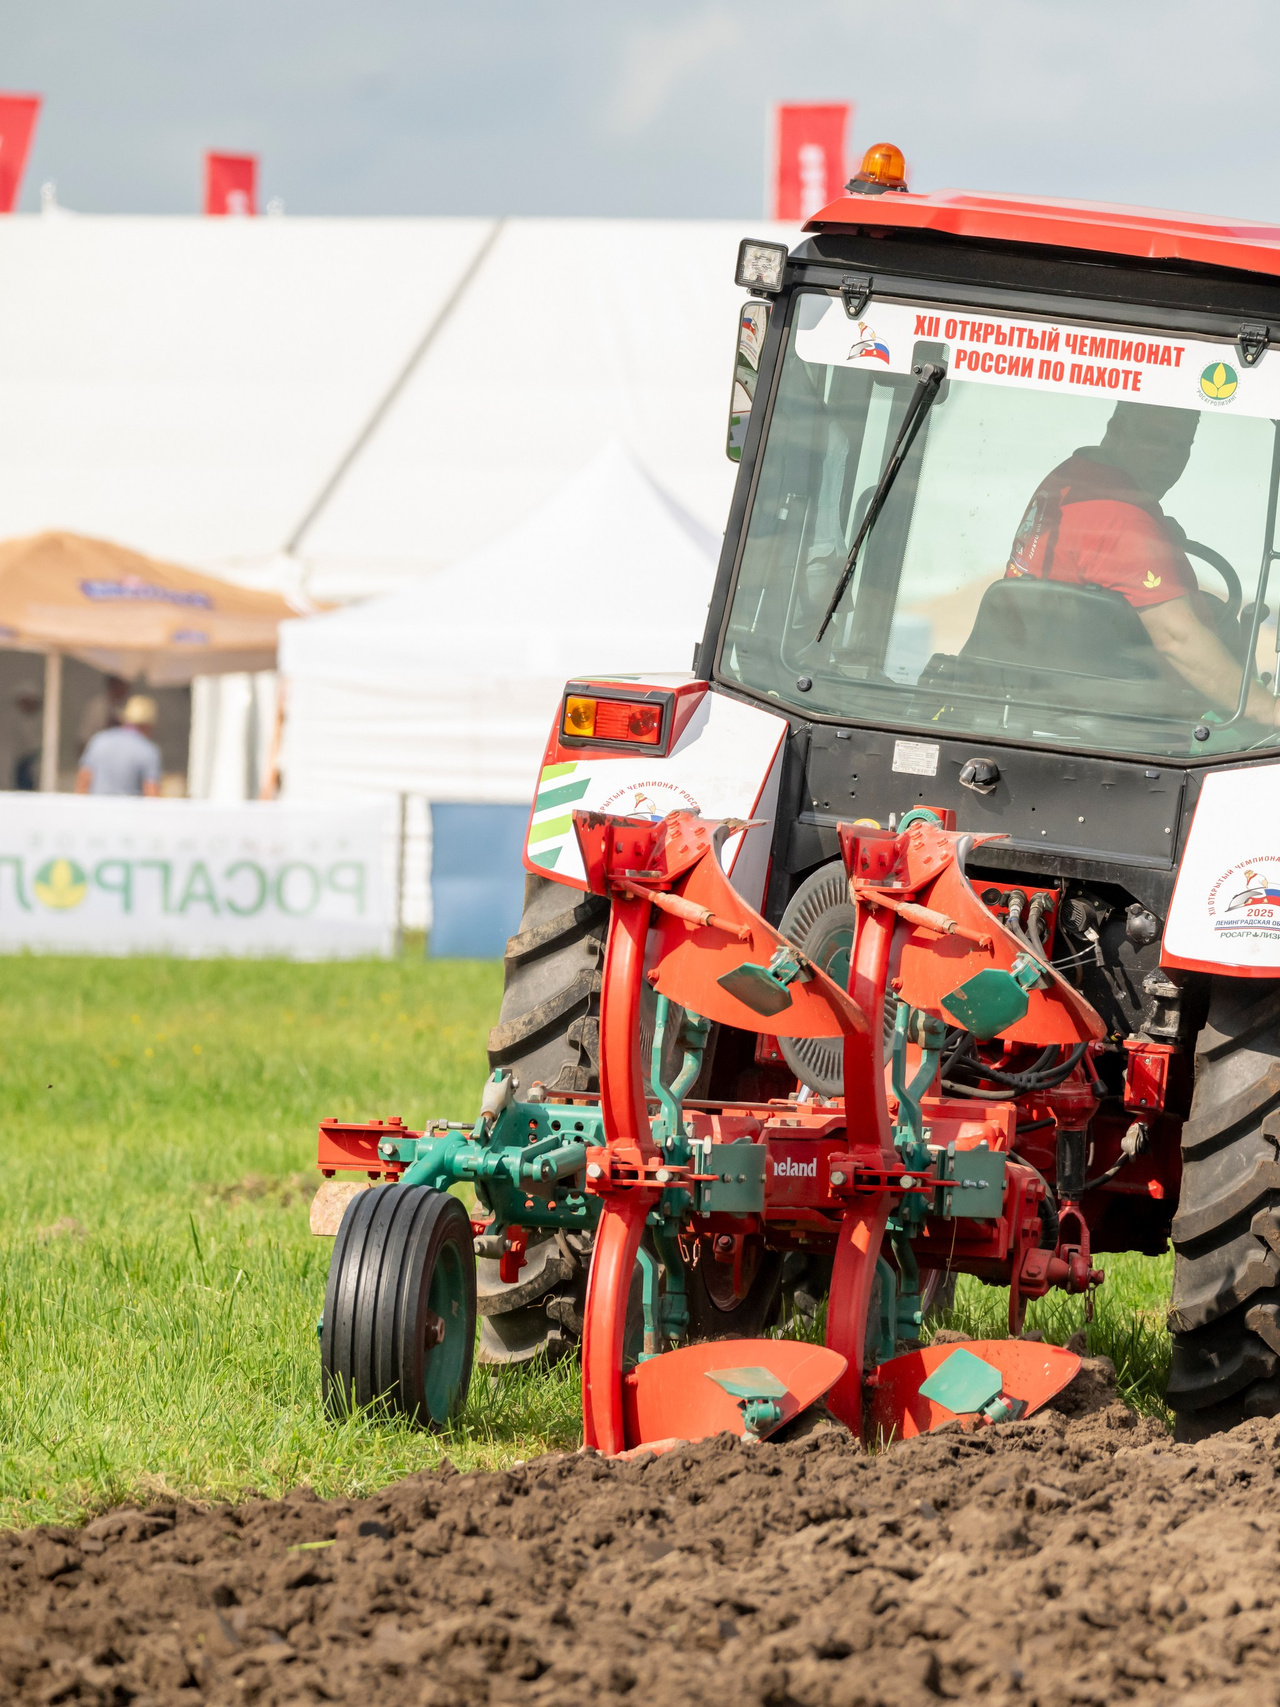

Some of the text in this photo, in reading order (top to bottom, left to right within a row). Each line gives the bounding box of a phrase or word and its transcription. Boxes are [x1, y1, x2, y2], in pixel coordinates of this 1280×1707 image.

[913, 314, 1186, 368] XII ОТКРЫТЫЙ ЧЕМПИОНАТ
[954, 349, 1143, 392] РОССИИ ПО ПАХОТЕ
[627, 781, 679, 792] ЧЕМПИОНАТ
[1208, 869, 1234, 905] ОТКРЫТЫЙ
[1247, 908, 1274, 918] 2025
